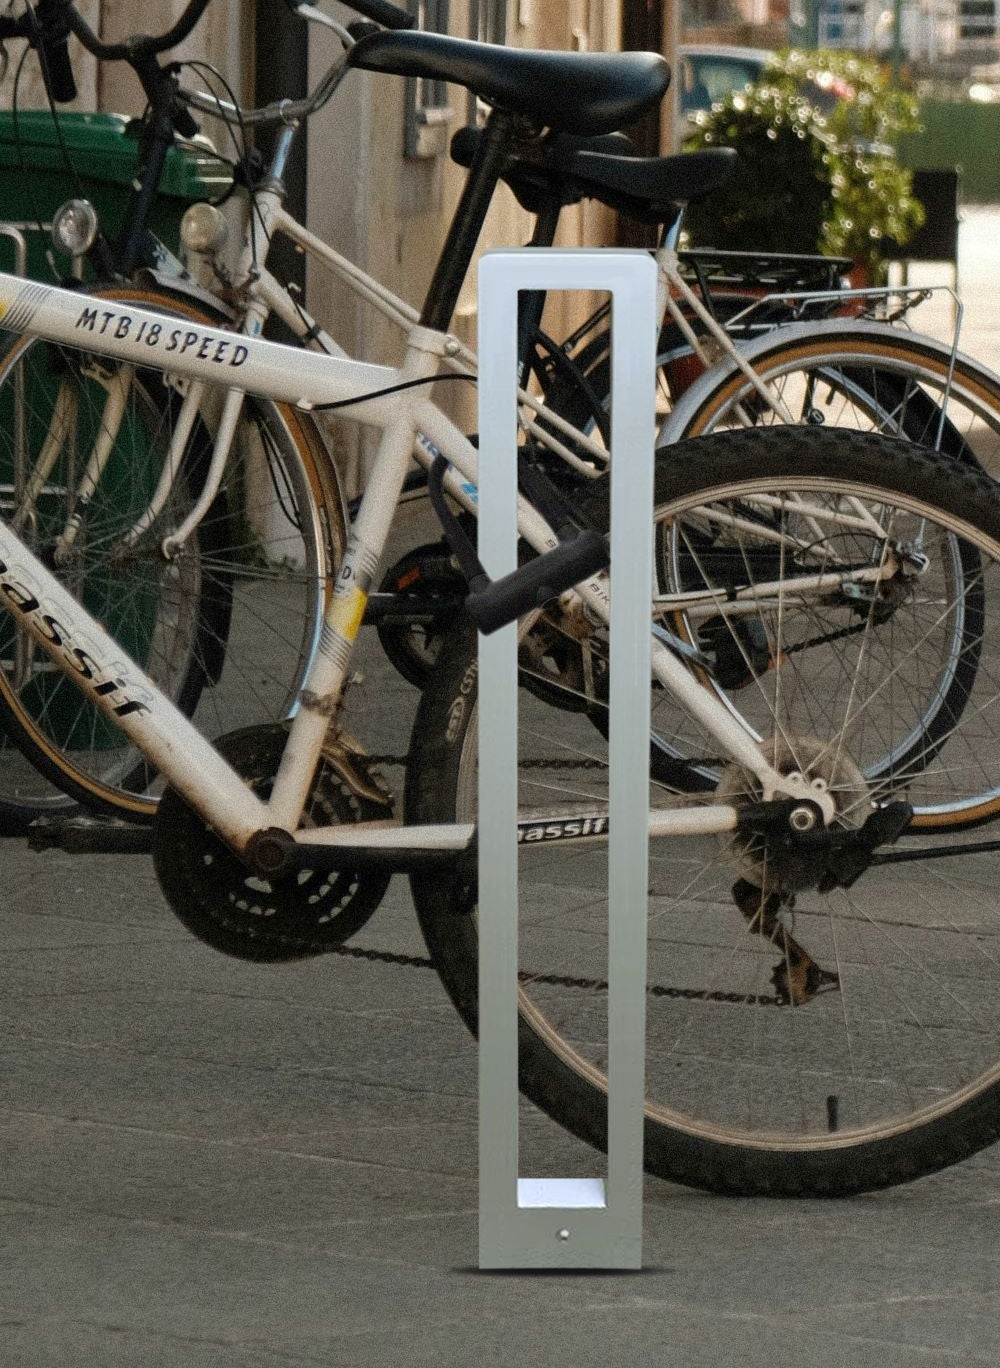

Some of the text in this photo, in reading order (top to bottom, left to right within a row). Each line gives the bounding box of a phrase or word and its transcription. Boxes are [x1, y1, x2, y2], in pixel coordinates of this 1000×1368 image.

[75, 307, 249, 367] MTB 18 SPEED
[0, 559, 153, 717] assif
